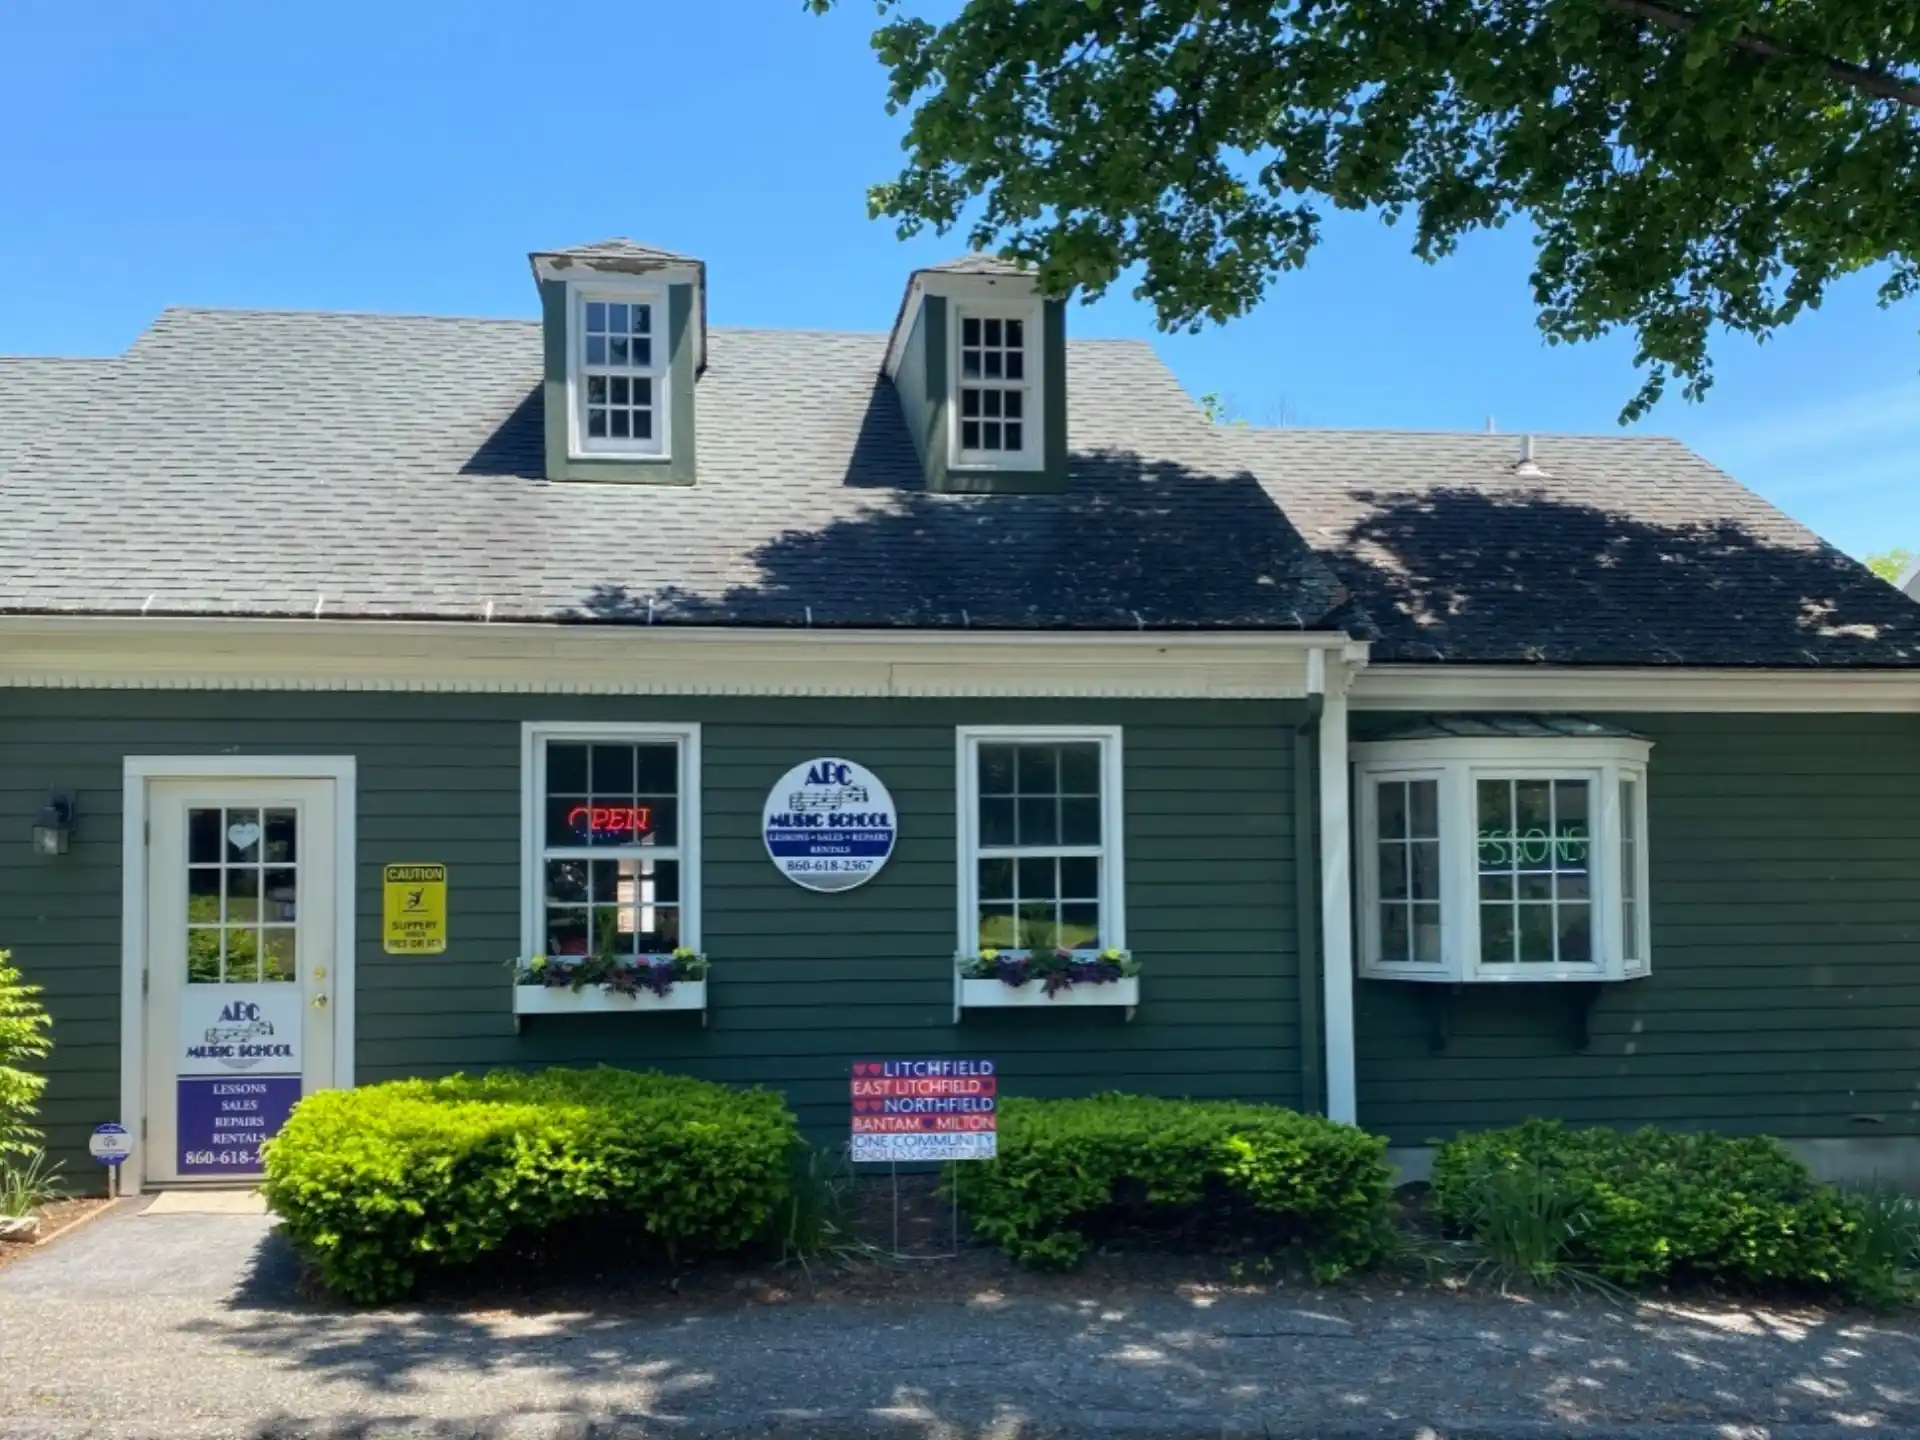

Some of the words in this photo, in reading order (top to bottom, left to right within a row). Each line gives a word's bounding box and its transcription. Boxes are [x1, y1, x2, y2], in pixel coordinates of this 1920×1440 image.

[805, 761, 853, 786] ABC
[568, 806, 651, 830] OPEN
[768, 814, 824, 827] MUSIC
[828, 813, 892, 827] SCHOOL
[769, 832, 810, 842] LESSONS
[817, 832, 844, 842] SALES
[852, 832, 889, 842] REPAIRS
[810, 844, 851, 854] RENTALS
[1478, 826, 1586, 865] ESSONS
[388, 867, 443, 880] CAUTION
[218, 1001, 261, 1023] ABC
[186, 1045, 234, 1058] MUSIC
[238, 1044, 294, 1058] SCHOOL
[884, 1061, 994, 1076] LITCHFIELD
[213, 1083, 267, 1095] LESSONS
[854, 1080, 891, 1095] EAST
[896, 1079, 980, 1094] LITCHFIELD
[221, 1099, 258, 1111] SALES
[884, 1096, 994, 1113] NORTHFIELD
[215, 1116, 265, 1127] REPAIRS
[854, 1116, 920, 1132] BANTAM
[936, 1115, 995, 1131] MILTON
[212, 1132, 266, 1144] RENTALS
[854, 1135, 888, 1148] ONE
[893, 1133, 993, 1148] COMMUNITY
[186, 1151, 261, 1164] 860-618-2
